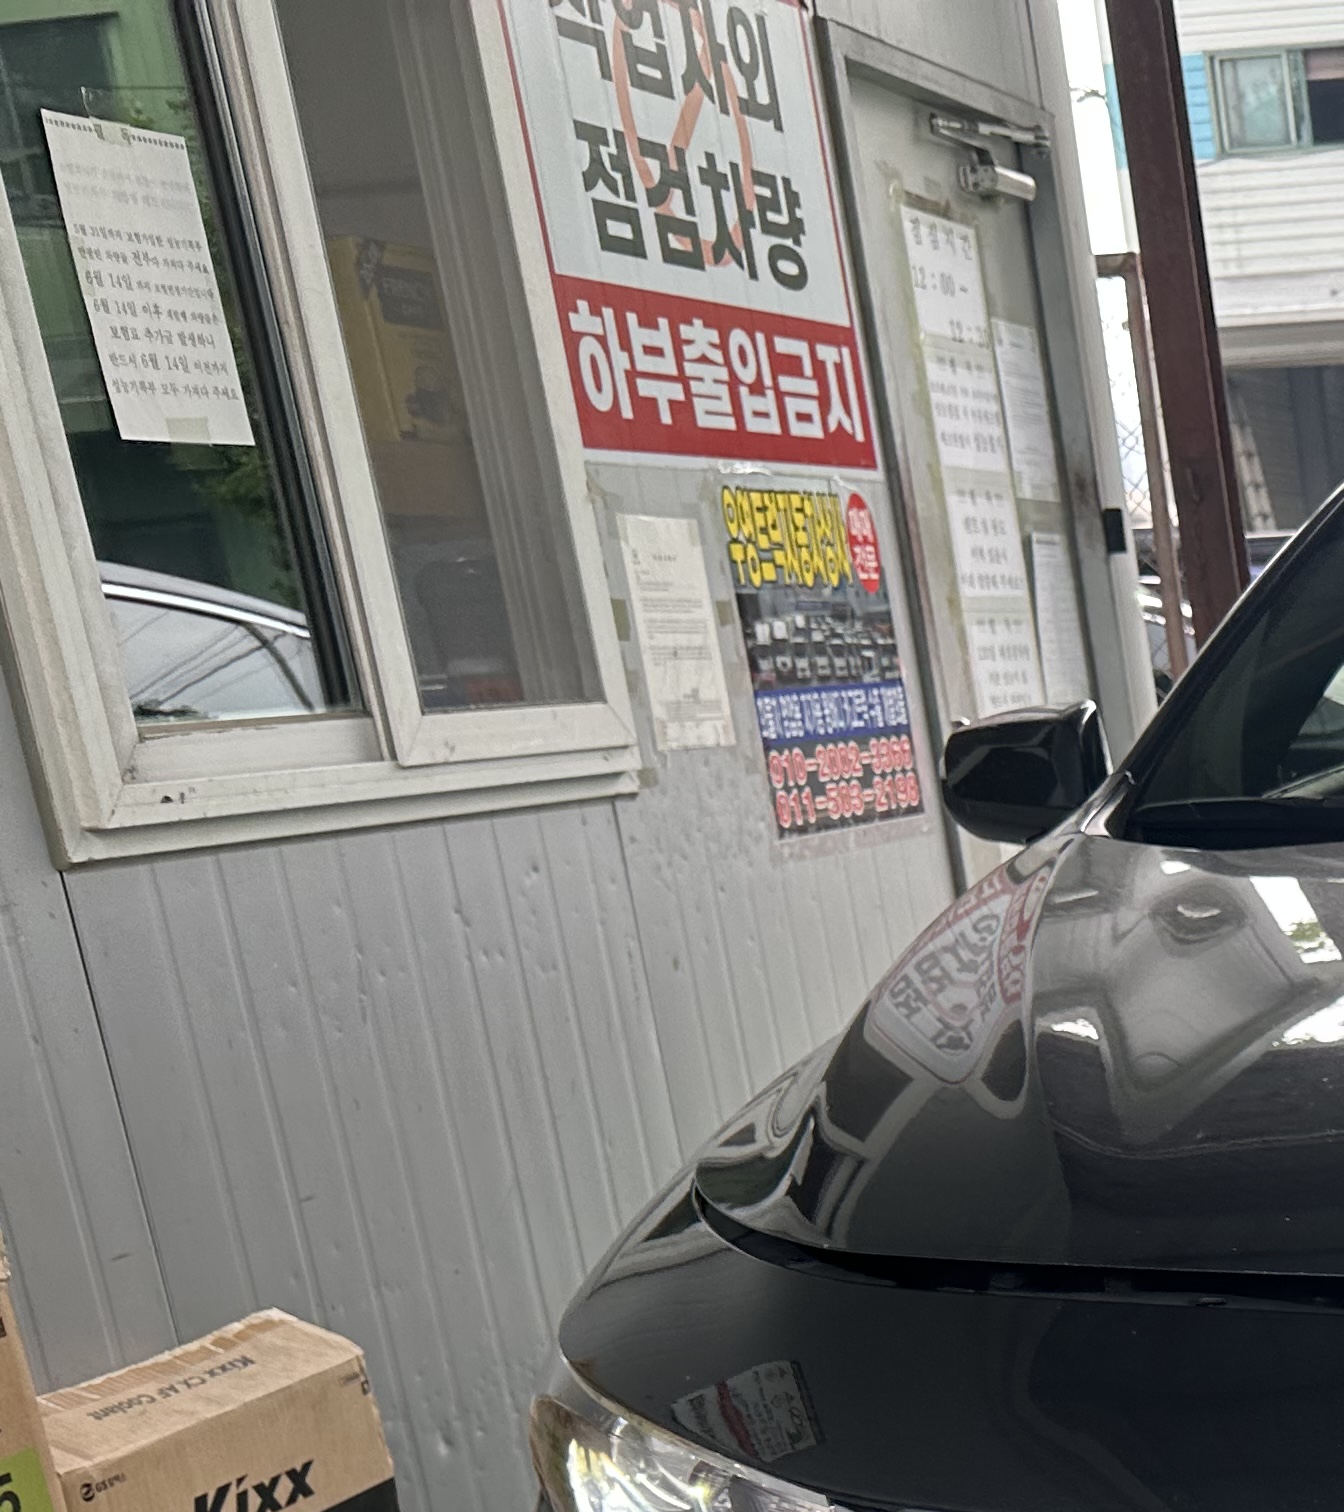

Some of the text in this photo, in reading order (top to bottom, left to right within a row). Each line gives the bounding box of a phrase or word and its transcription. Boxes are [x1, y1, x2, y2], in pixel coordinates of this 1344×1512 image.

[573, 119, 809, 291] 점검차량
[114, 299, 138, 317] 14일
[141, 352, 161, 370] 6월
[165, 354, 191, 373] 14일
[568, 299, 865, 442] 하부출입금지
